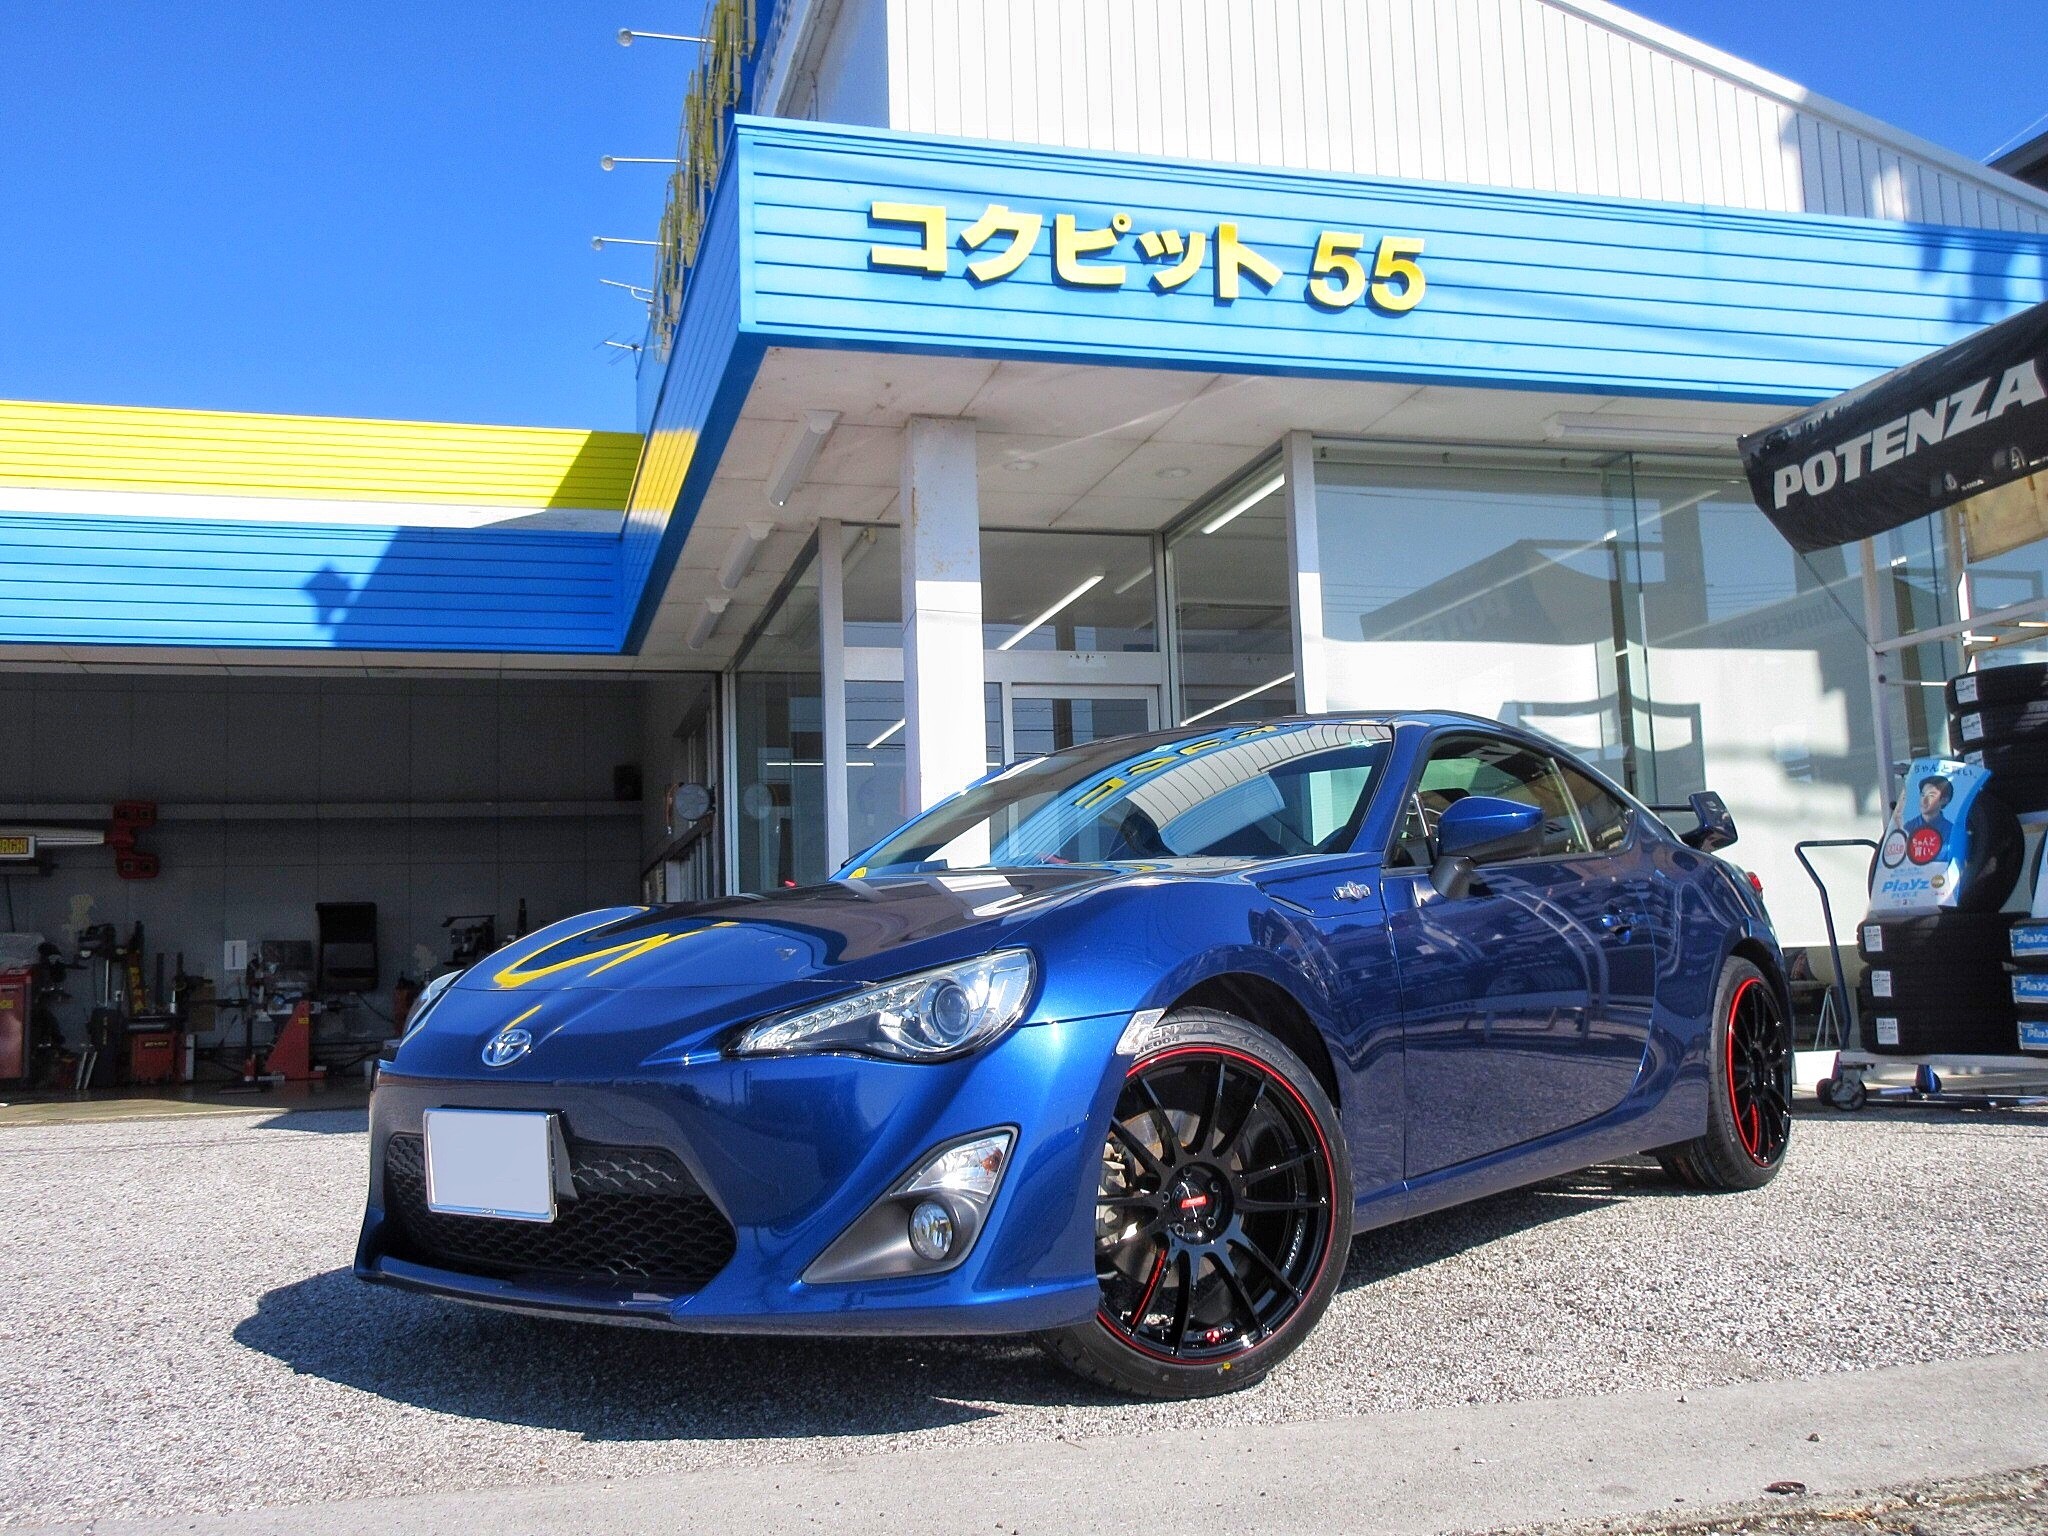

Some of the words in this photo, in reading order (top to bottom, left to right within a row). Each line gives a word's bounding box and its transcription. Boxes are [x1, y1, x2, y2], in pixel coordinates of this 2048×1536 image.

[870, 200, 1284, 300] コクピット
[1308, 230, 1427, 312] 55
[1773, 358, 2048, 510] POTENZA
